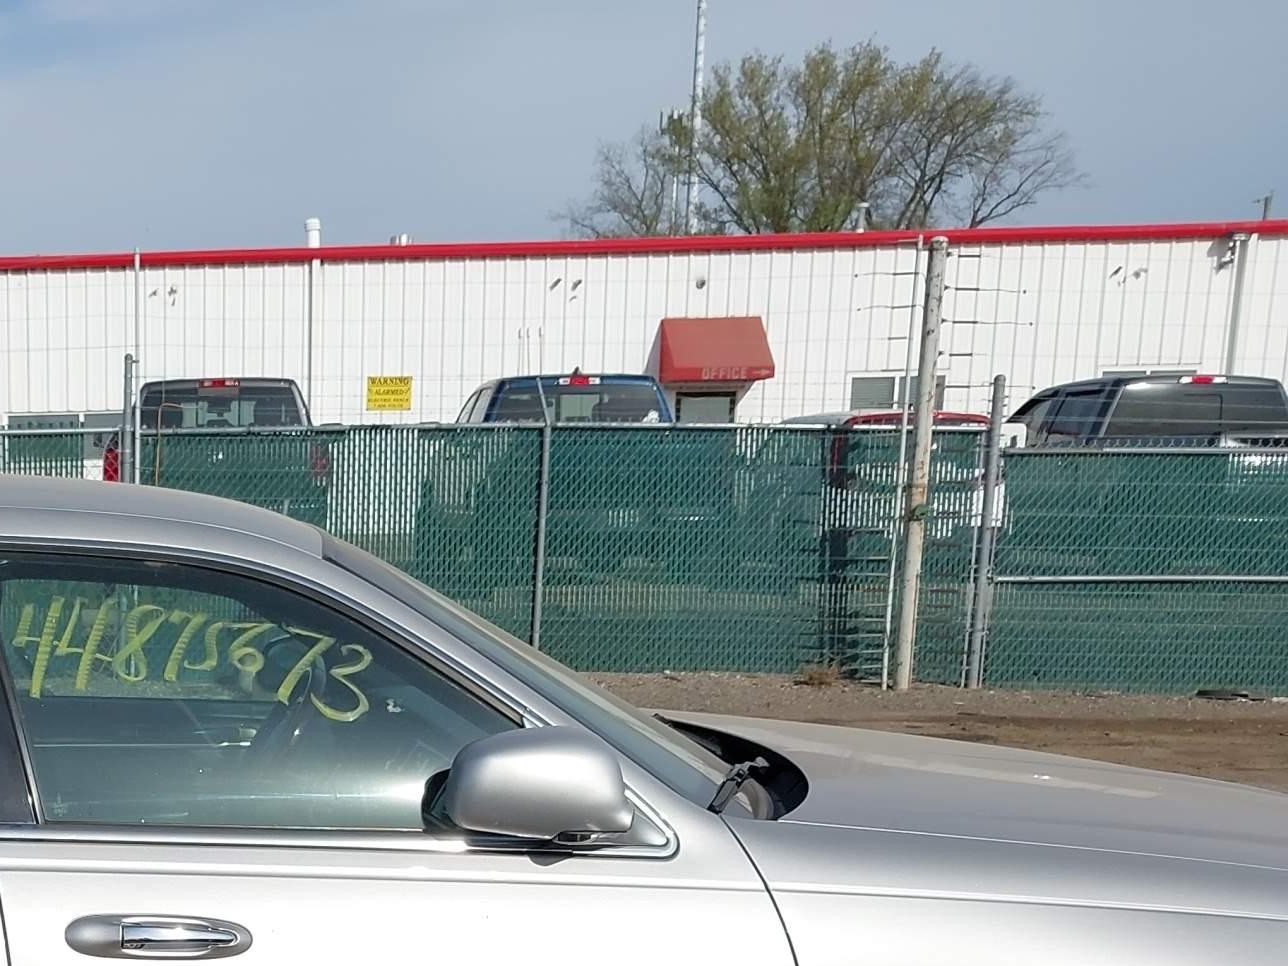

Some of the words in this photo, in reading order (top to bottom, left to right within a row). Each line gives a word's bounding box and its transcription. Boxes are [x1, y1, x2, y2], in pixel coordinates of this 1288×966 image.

[702, 367, 747, 379] OFFICE
[368, 376, 410, 386] WARNING
[12, 596, 372, 722] 44875673
